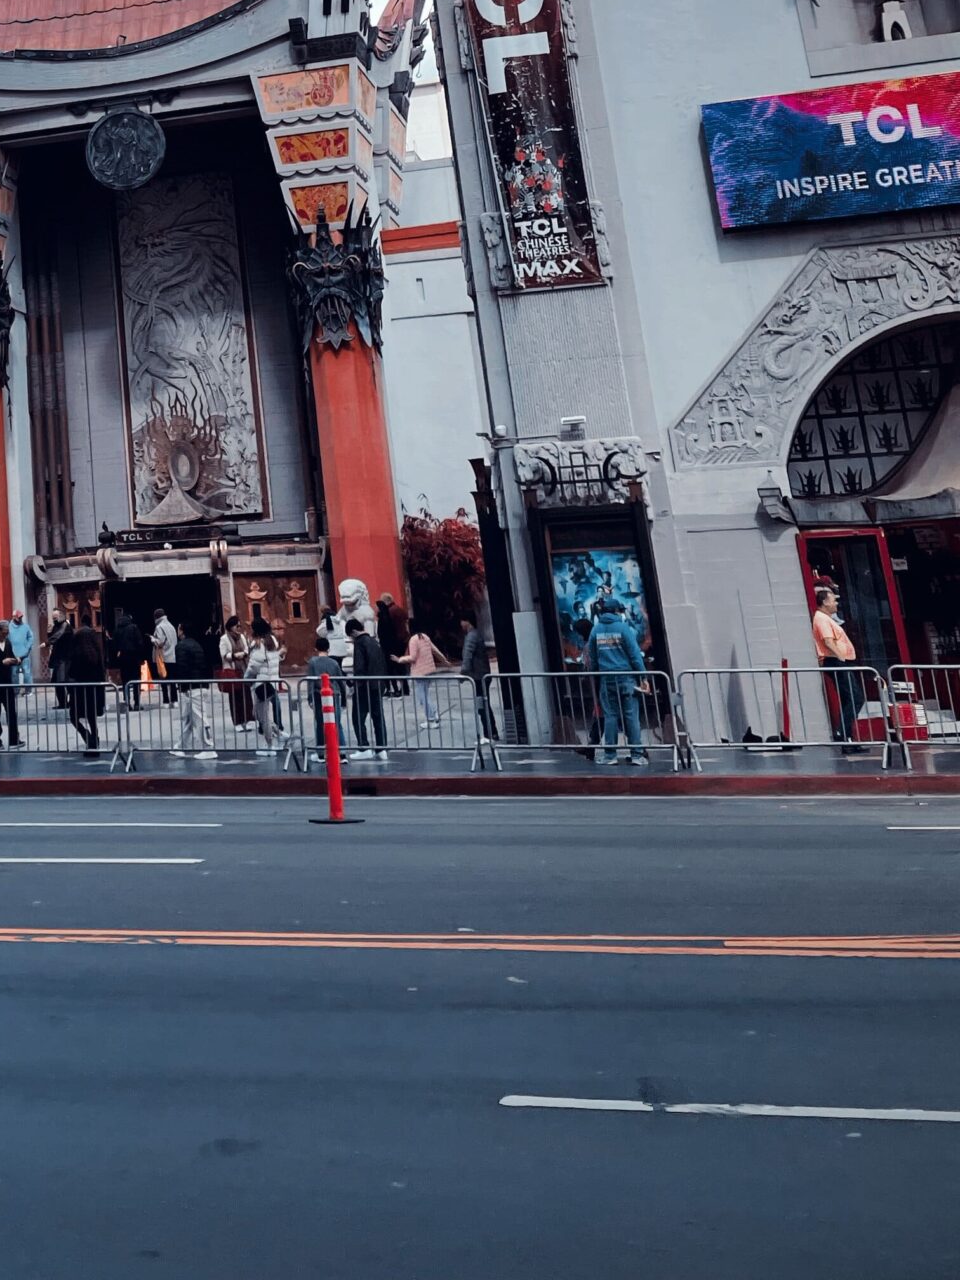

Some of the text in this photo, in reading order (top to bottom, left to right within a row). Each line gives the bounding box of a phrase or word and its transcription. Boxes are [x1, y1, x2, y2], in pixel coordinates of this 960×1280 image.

[827, 104, 944, 146] TCL
[776, 171, 870, 199] INSPIRE
[514, 217, 568, 238] TCL
[517, 235, 569, 250] CHINESE
[519, 246, 571, 259] THEATRES
[121, 533, 142, 542] TCL
